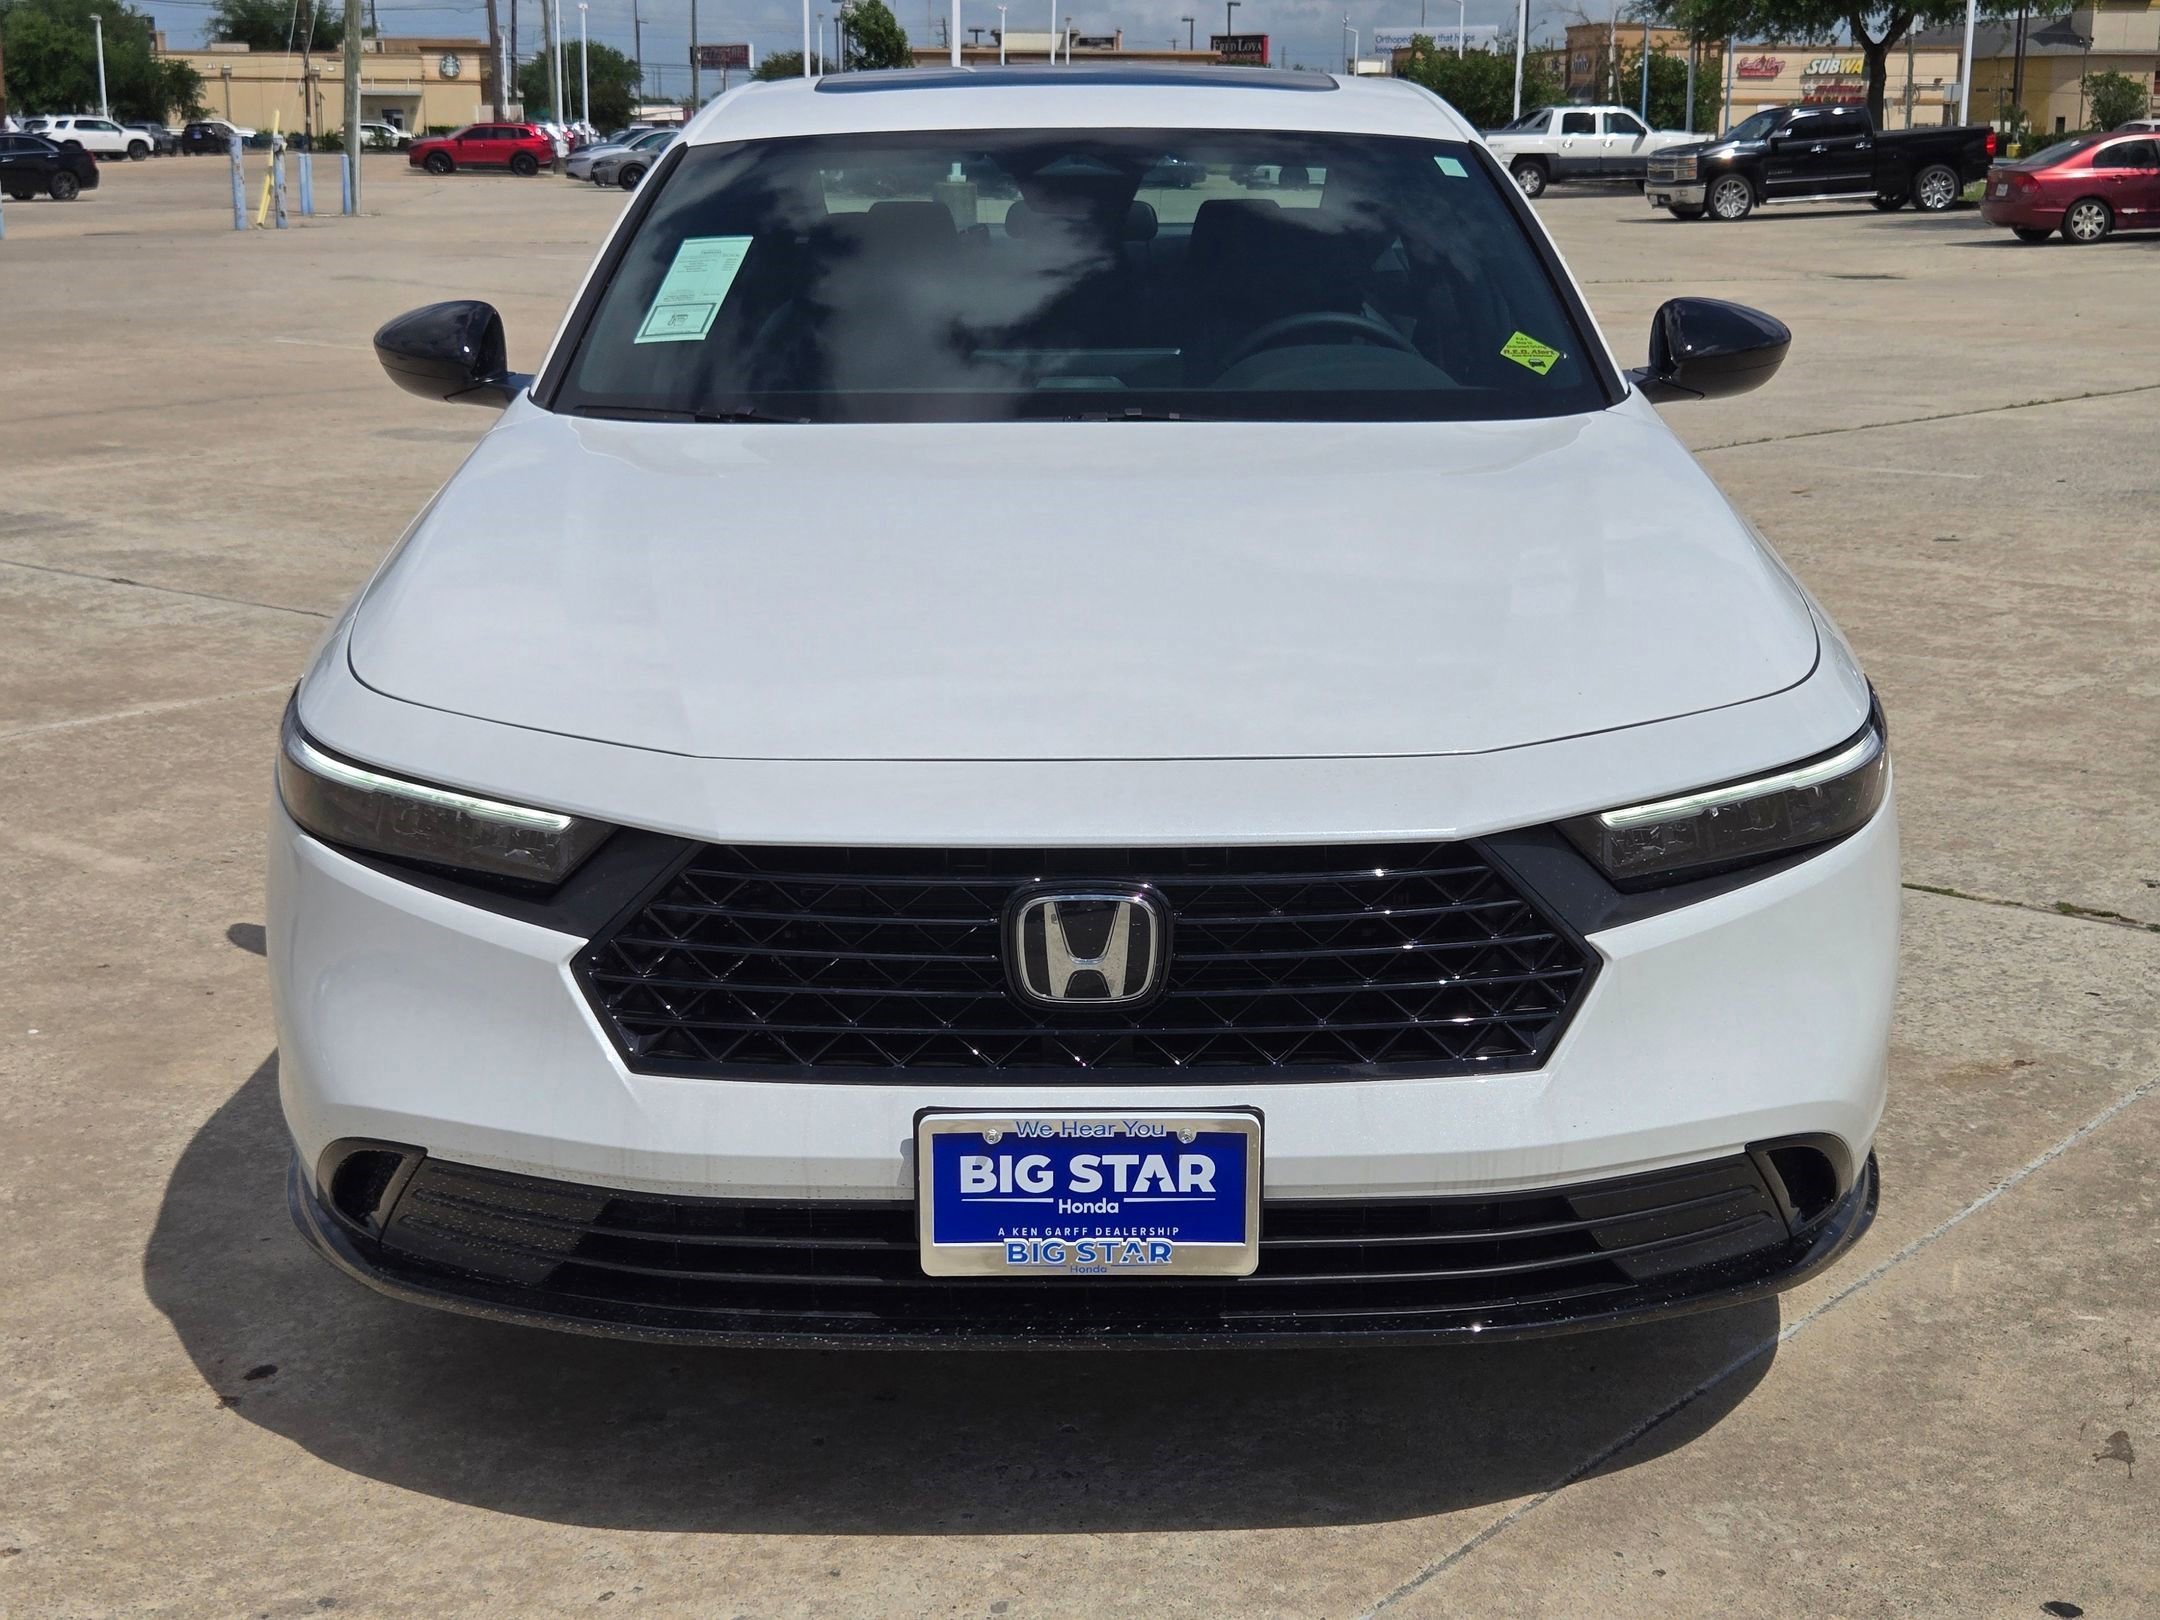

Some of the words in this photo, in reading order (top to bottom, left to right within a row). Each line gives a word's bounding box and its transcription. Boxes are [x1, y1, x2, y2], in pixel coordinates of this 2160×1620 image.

[1375, 34, 1413, 44] Orthoped
[1438, 33, 1454, 43] that
[1454, 32, 1476, 46] hlps
[1805, 58, 1864, 75] SUBWA
[1016, 1120, 1053, 1137] We
[1060, 1120, 1116, 1137] Hear
[1123, 1120, 1166, 1137] You
[960, 1154, 1054, 1194] BIG
[1068, 1154, 1216, 1193] STAR
[1058, 1198, 1119, 1214] Honda
[998, 1227, 1005, 1236] A
[1012, 1227, 1038, 1236] KEN
[1045, 1227, 1088, 1236] GARFF
[1095, 1226, 1180, 1236] DEALERSHIP
[1007, 1241, 1066, 1264] BIG
[1076, 1241, 1172, 1264] STAR
[1070, 1264, 1107, 1274] Honda
